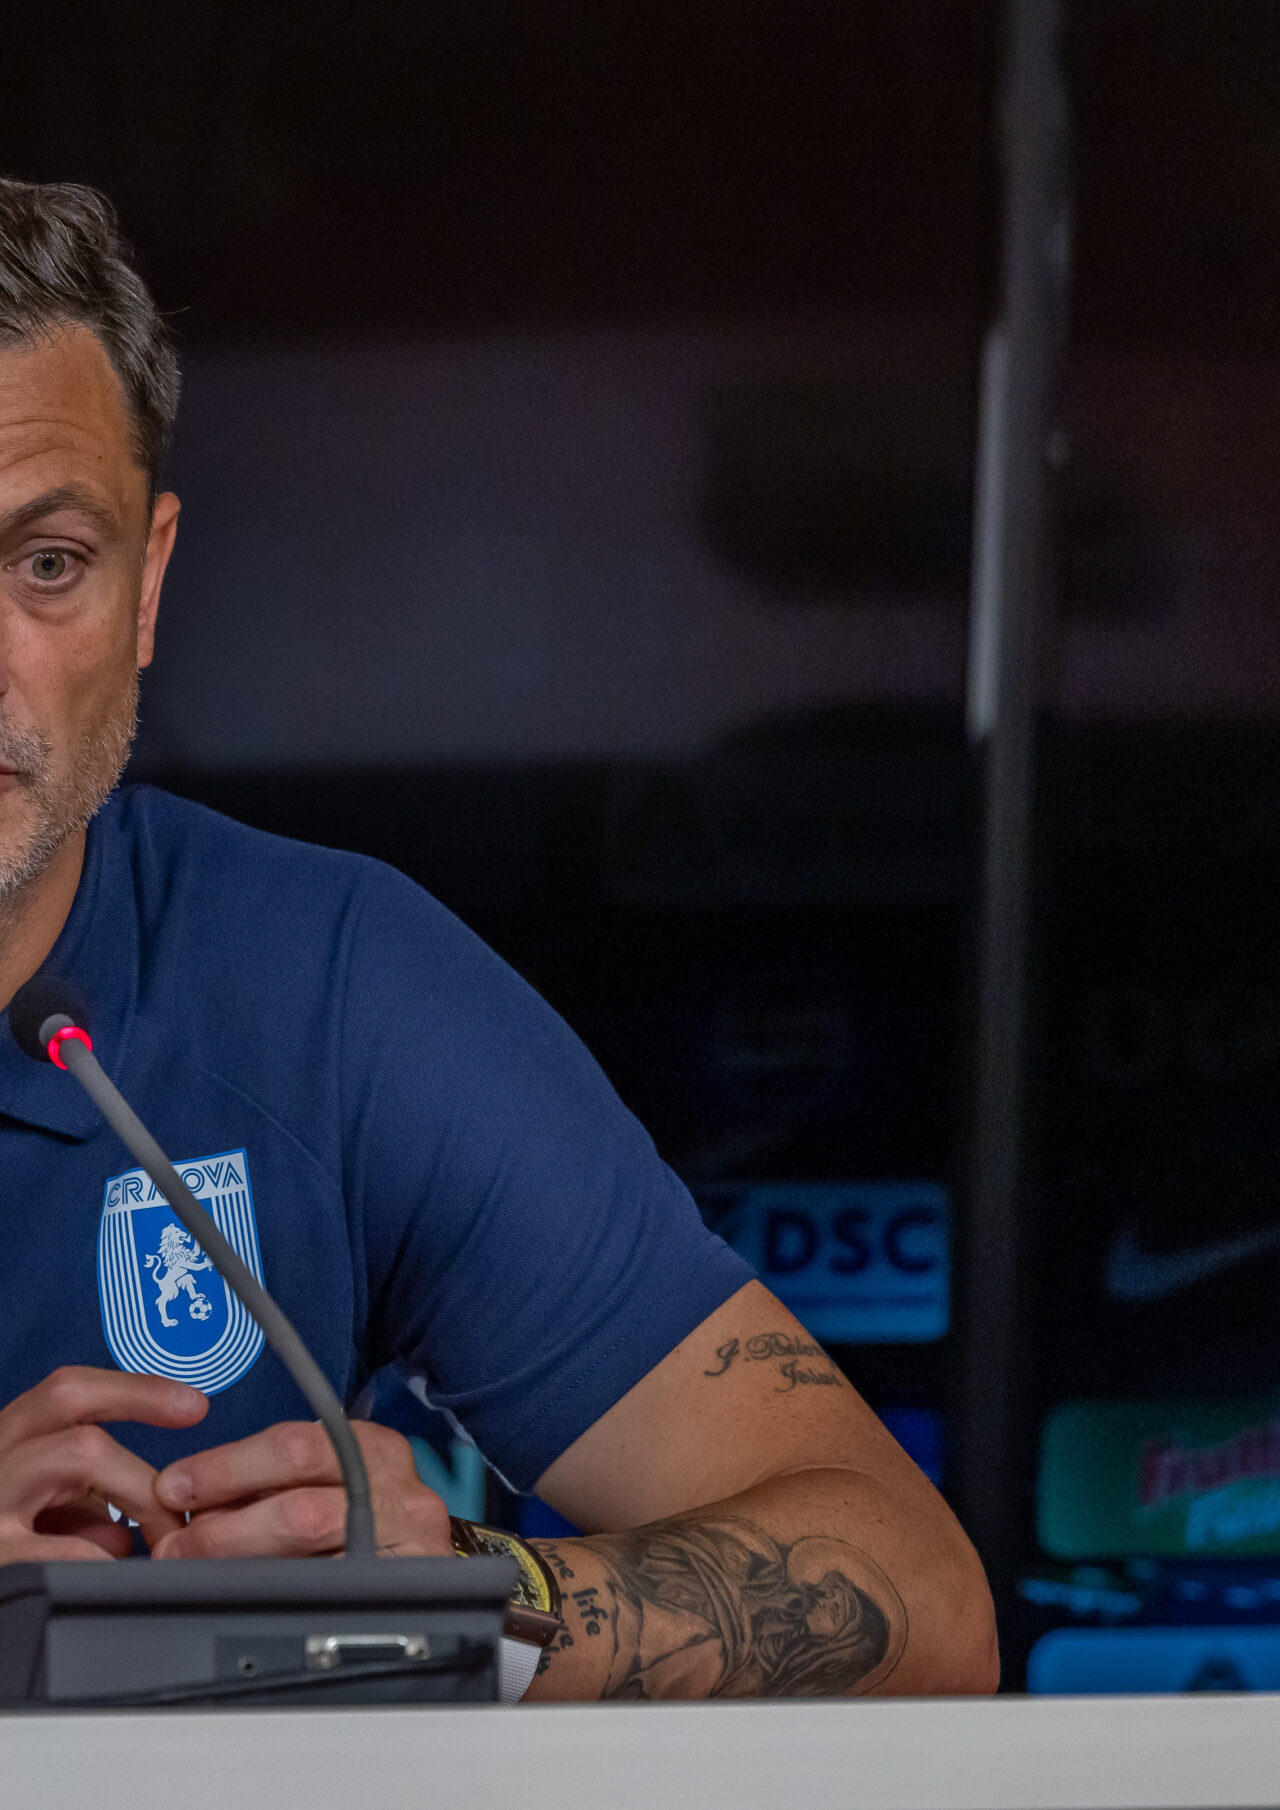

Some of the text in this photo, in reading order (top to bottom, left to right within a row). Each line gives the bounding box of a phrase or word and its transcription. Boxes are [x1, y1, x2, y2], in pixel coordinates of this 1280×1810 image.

[107, 1161, 244, 1208] CRAOVA
[765, 1205, 939, 1276] DSC
[572, 1587, 608, 1636] life
